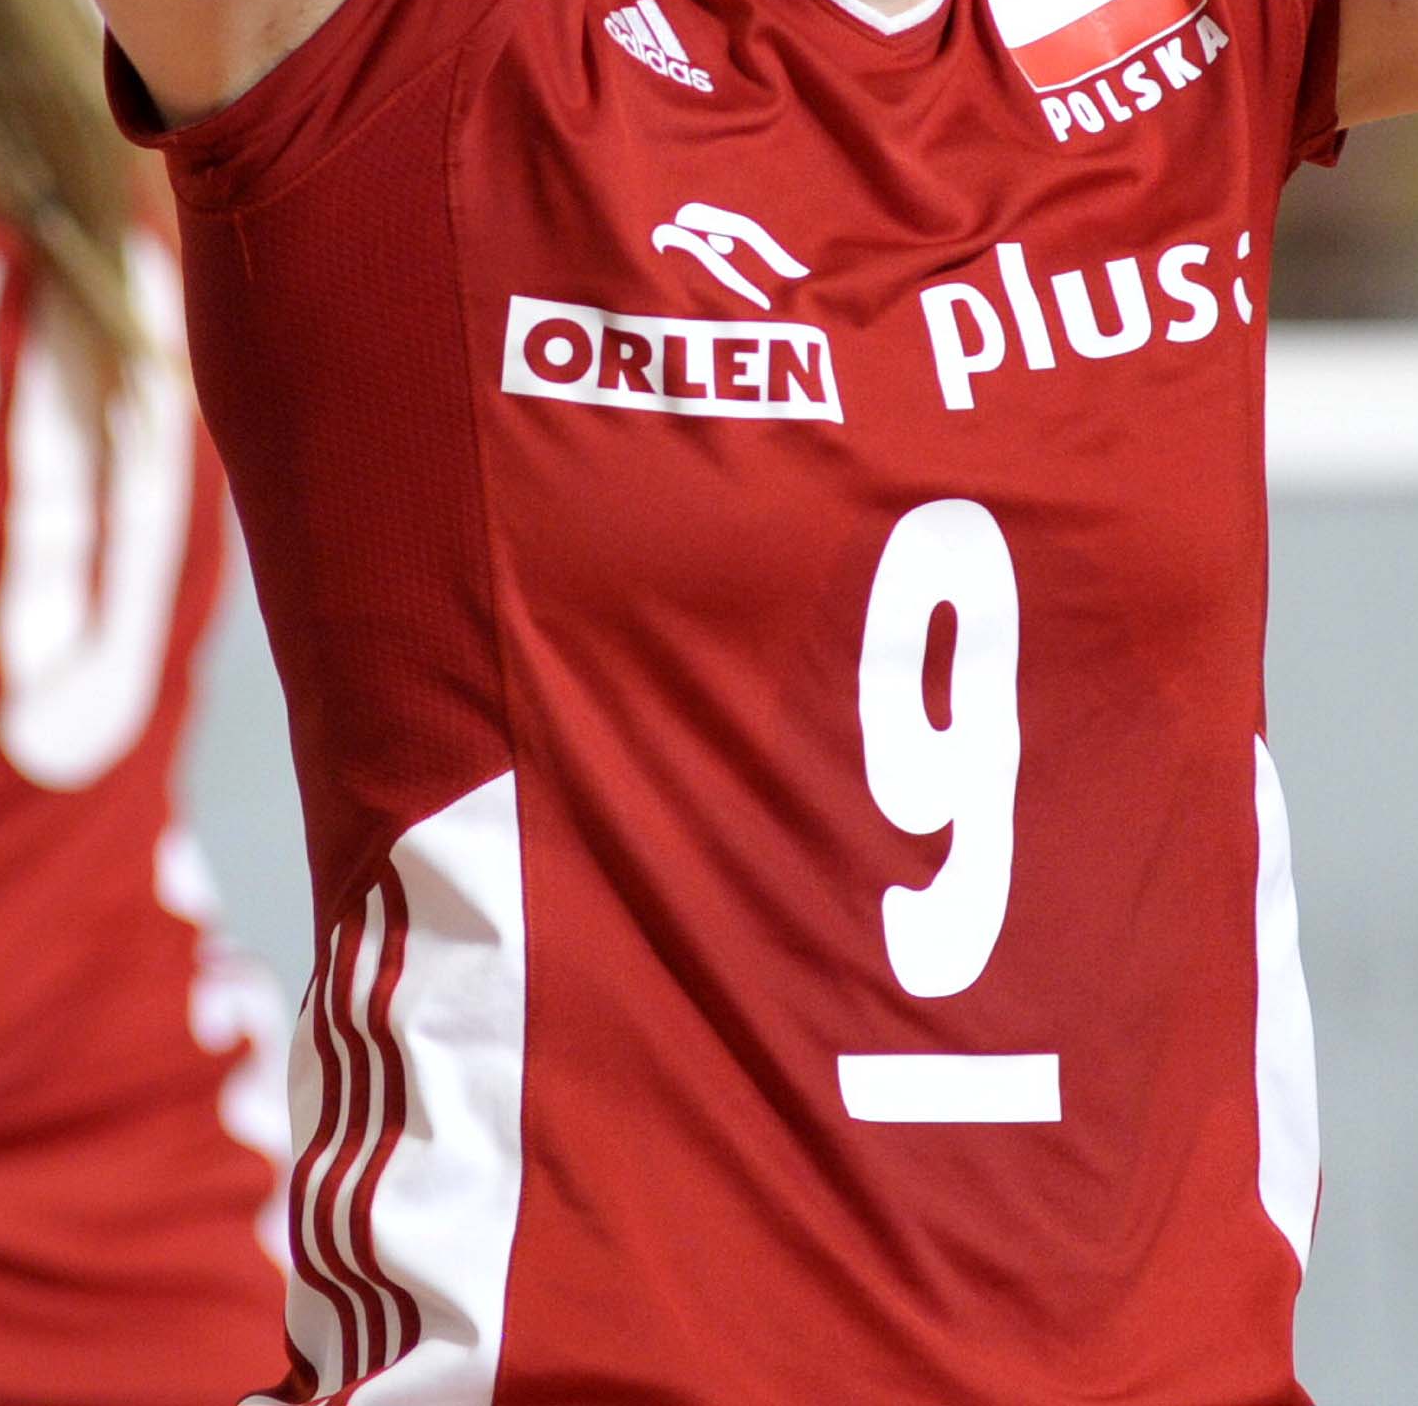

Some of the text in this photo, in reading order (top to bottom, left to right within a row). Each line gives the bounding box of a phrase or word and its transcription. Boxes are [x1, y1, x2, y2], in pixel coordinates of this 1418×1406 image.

[603, 17, 714, 93] adidas
[1039, 14, 1230, 143] POLSKA
[522, 317, 828, 403] ORLEN
[919, 242, 1219, 410] plus
[858, 497, 1022, 999] 9
